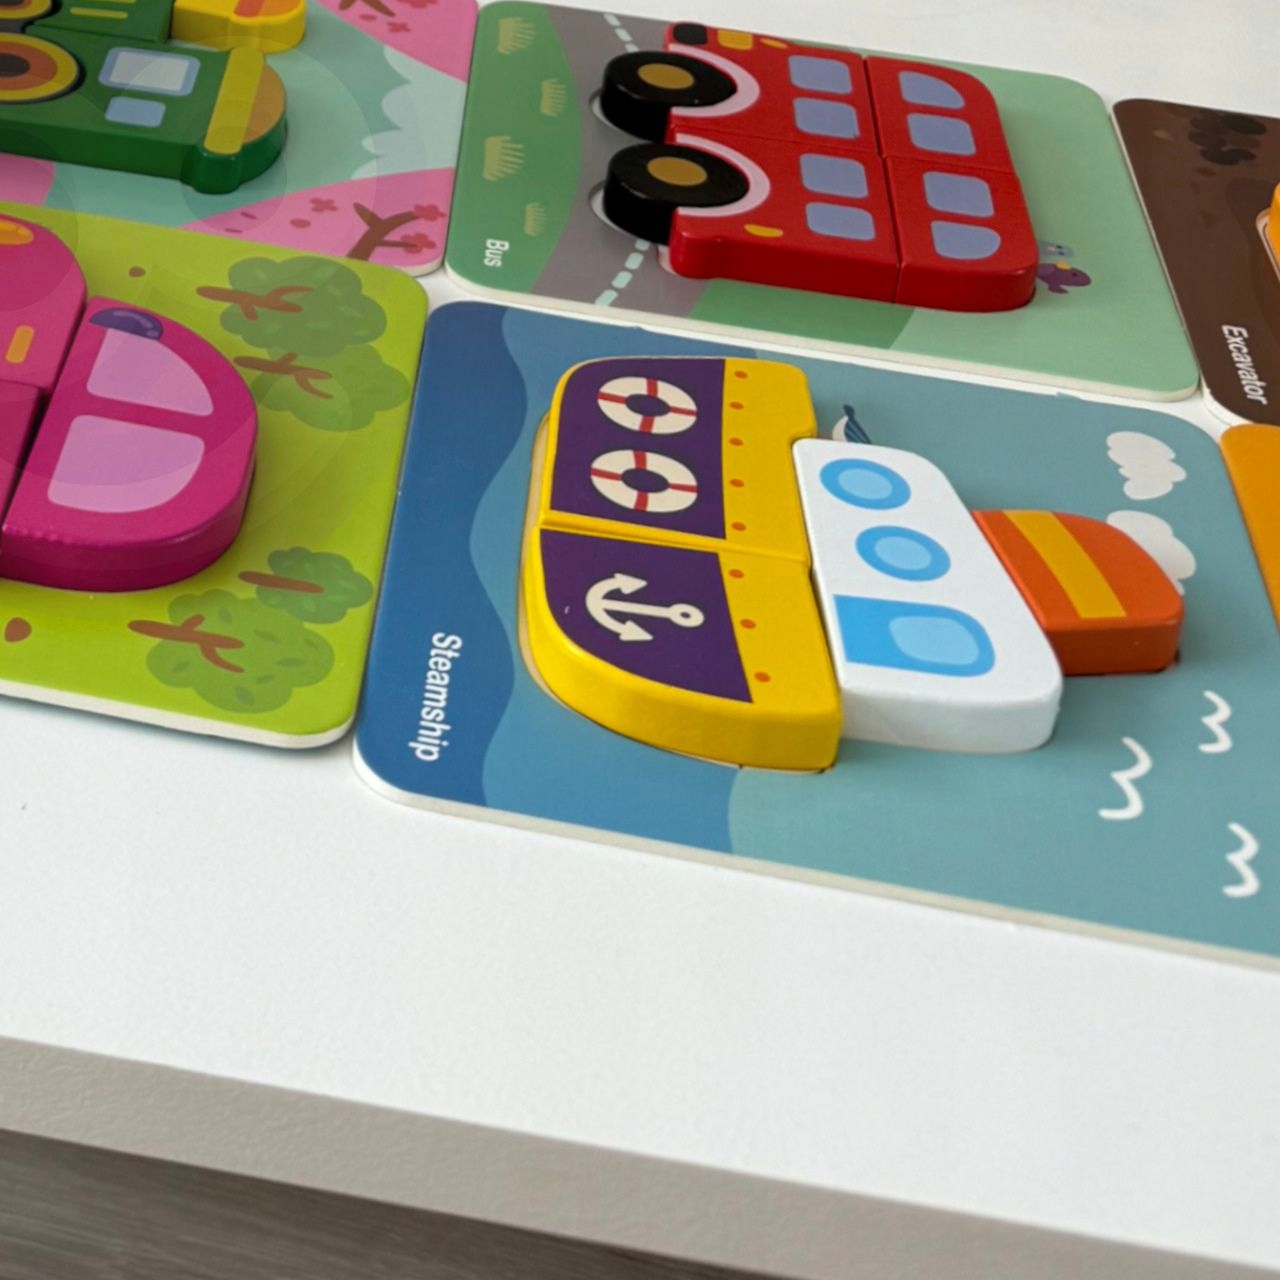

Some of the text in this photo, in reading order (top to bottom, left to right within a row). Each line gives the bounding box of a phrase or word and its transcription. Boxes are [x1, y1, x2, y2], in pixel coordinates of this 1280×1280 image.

[483, 238, 509, 267] Bus
[1221, 324, 1268, 406] Excavator
[408, 632, 463, 762] Steamship
